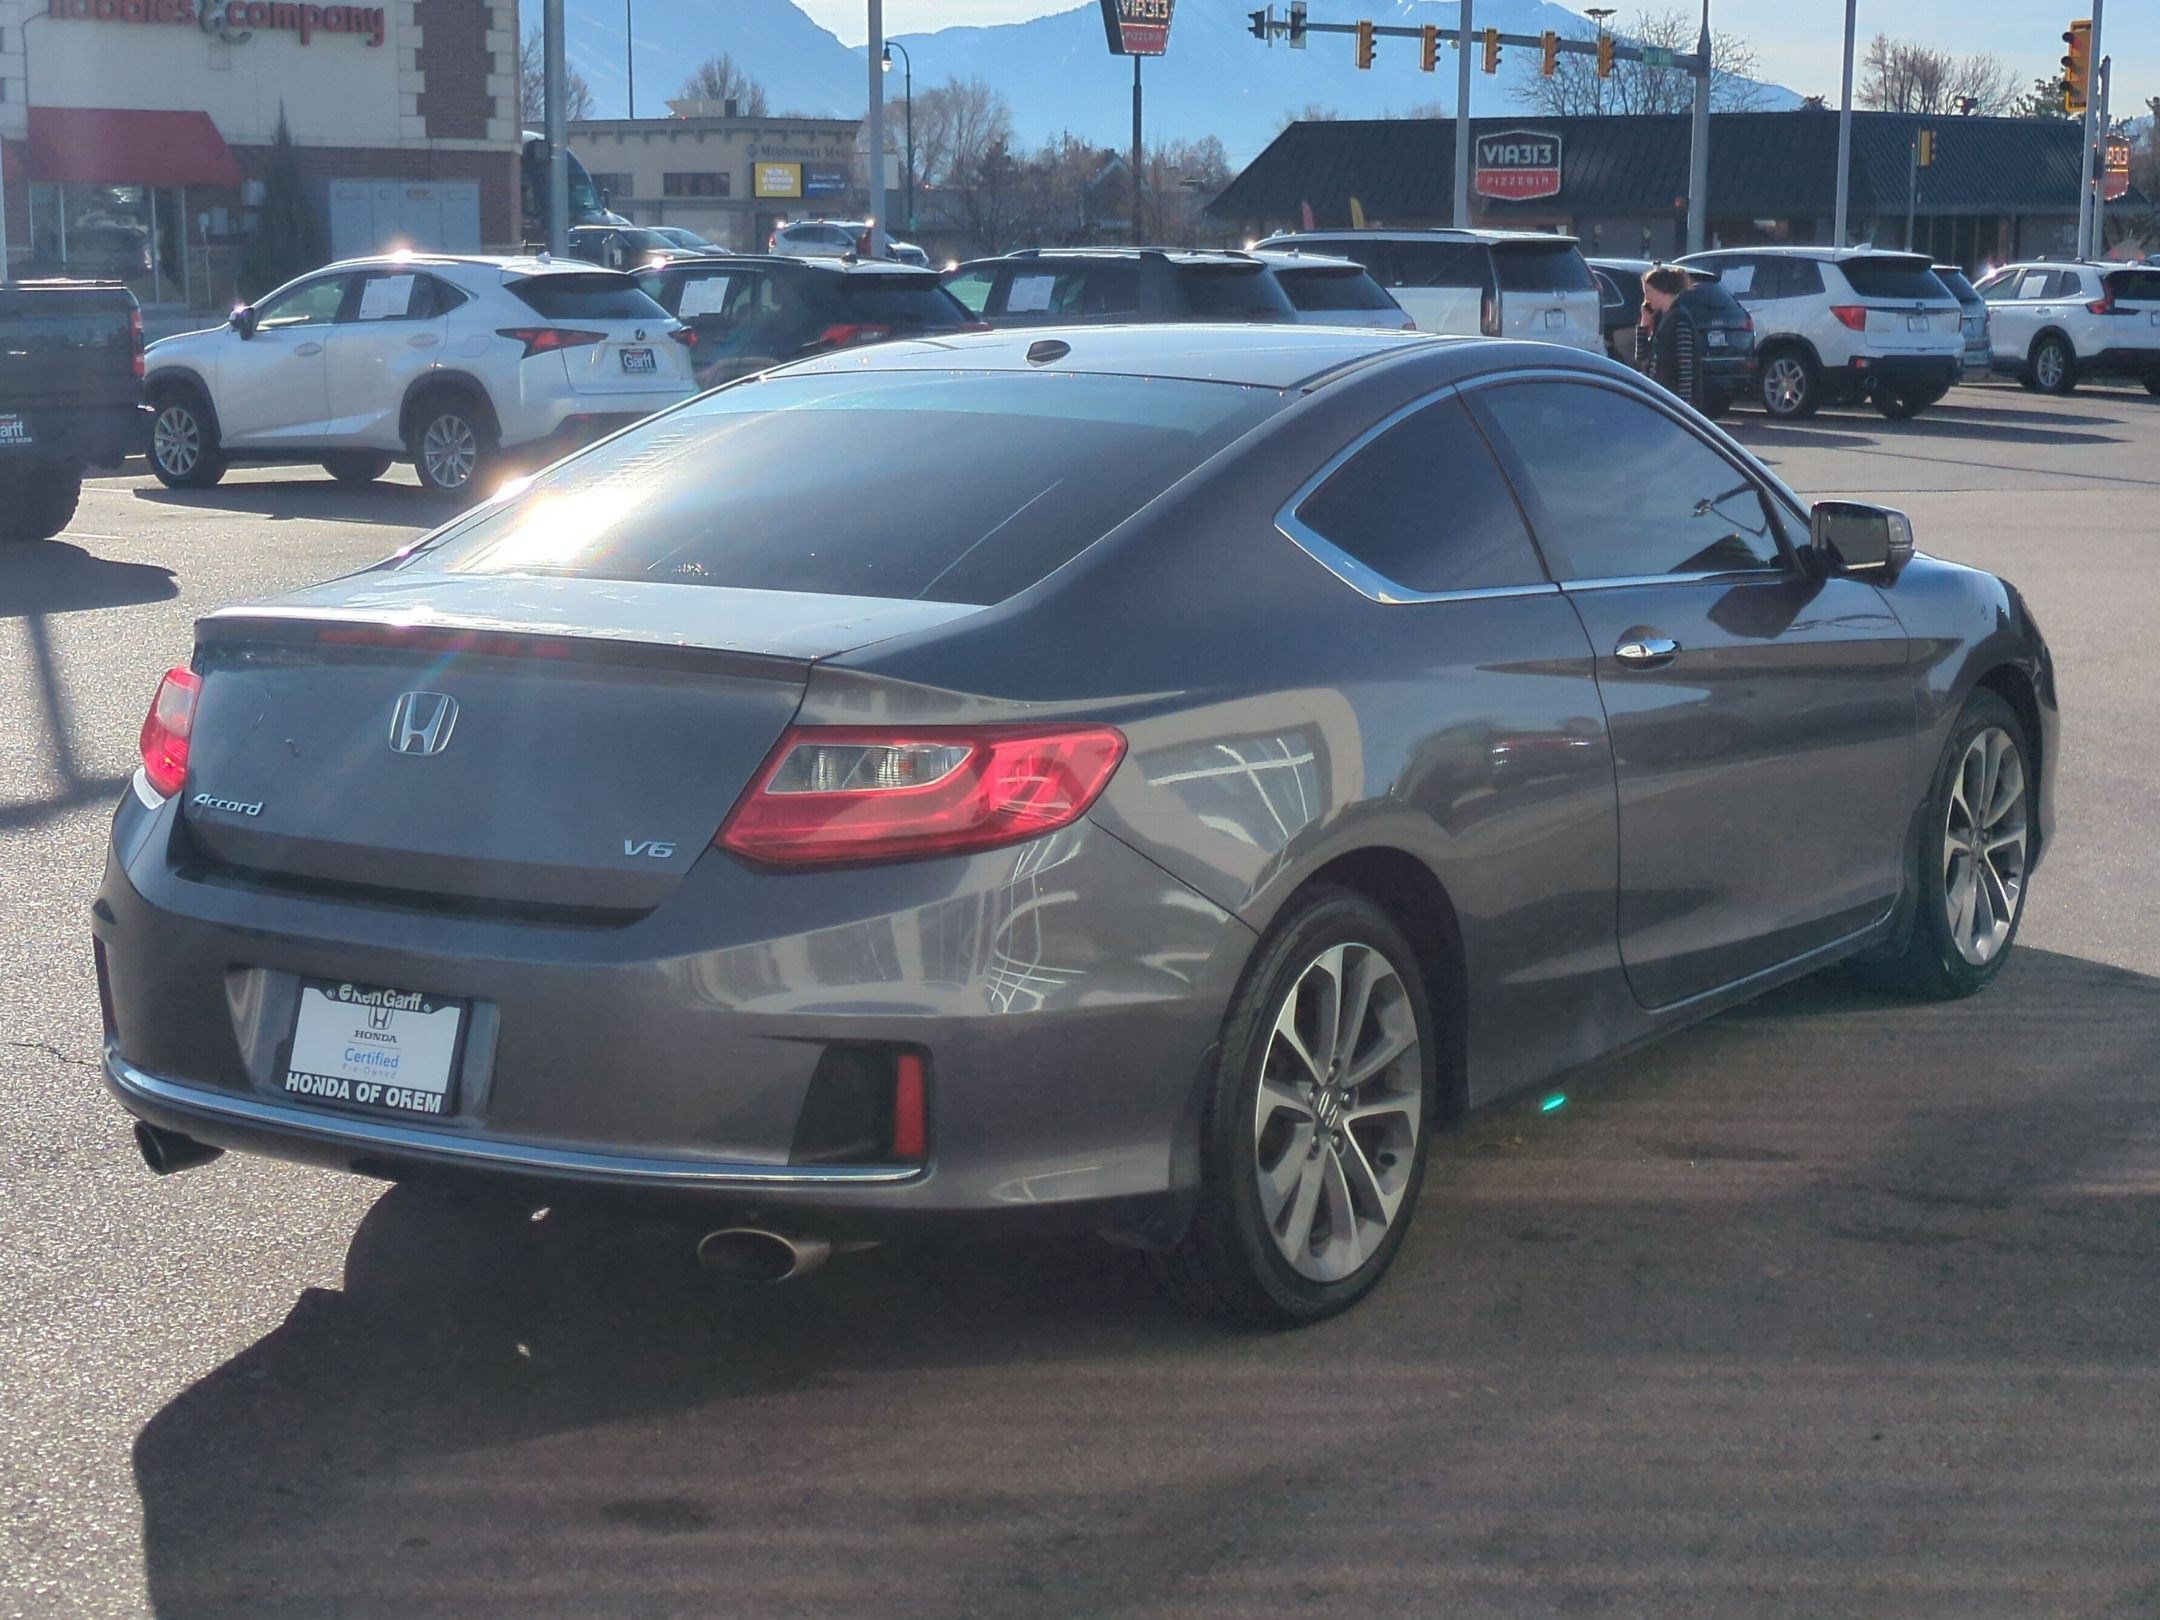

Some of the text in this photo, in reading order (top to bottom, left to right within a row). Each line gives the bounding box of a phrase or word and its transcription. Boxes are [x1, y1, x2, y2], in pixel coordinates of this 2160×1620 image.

[226, 1, 384, 47] company
[1482, 144, 1552, 164] VIA313
[0, 420, 24, 437] arff
[192, 793, 264, 816] Accord
[624, 839, 676, 858] V6
[383, 989, 423, 1011] Garff
[354, 1029, 398, 1044] HONDA
[344, 1047, 399, 1069] Certified
[285, 1072, 442, 1114] HONDA OF OREM
